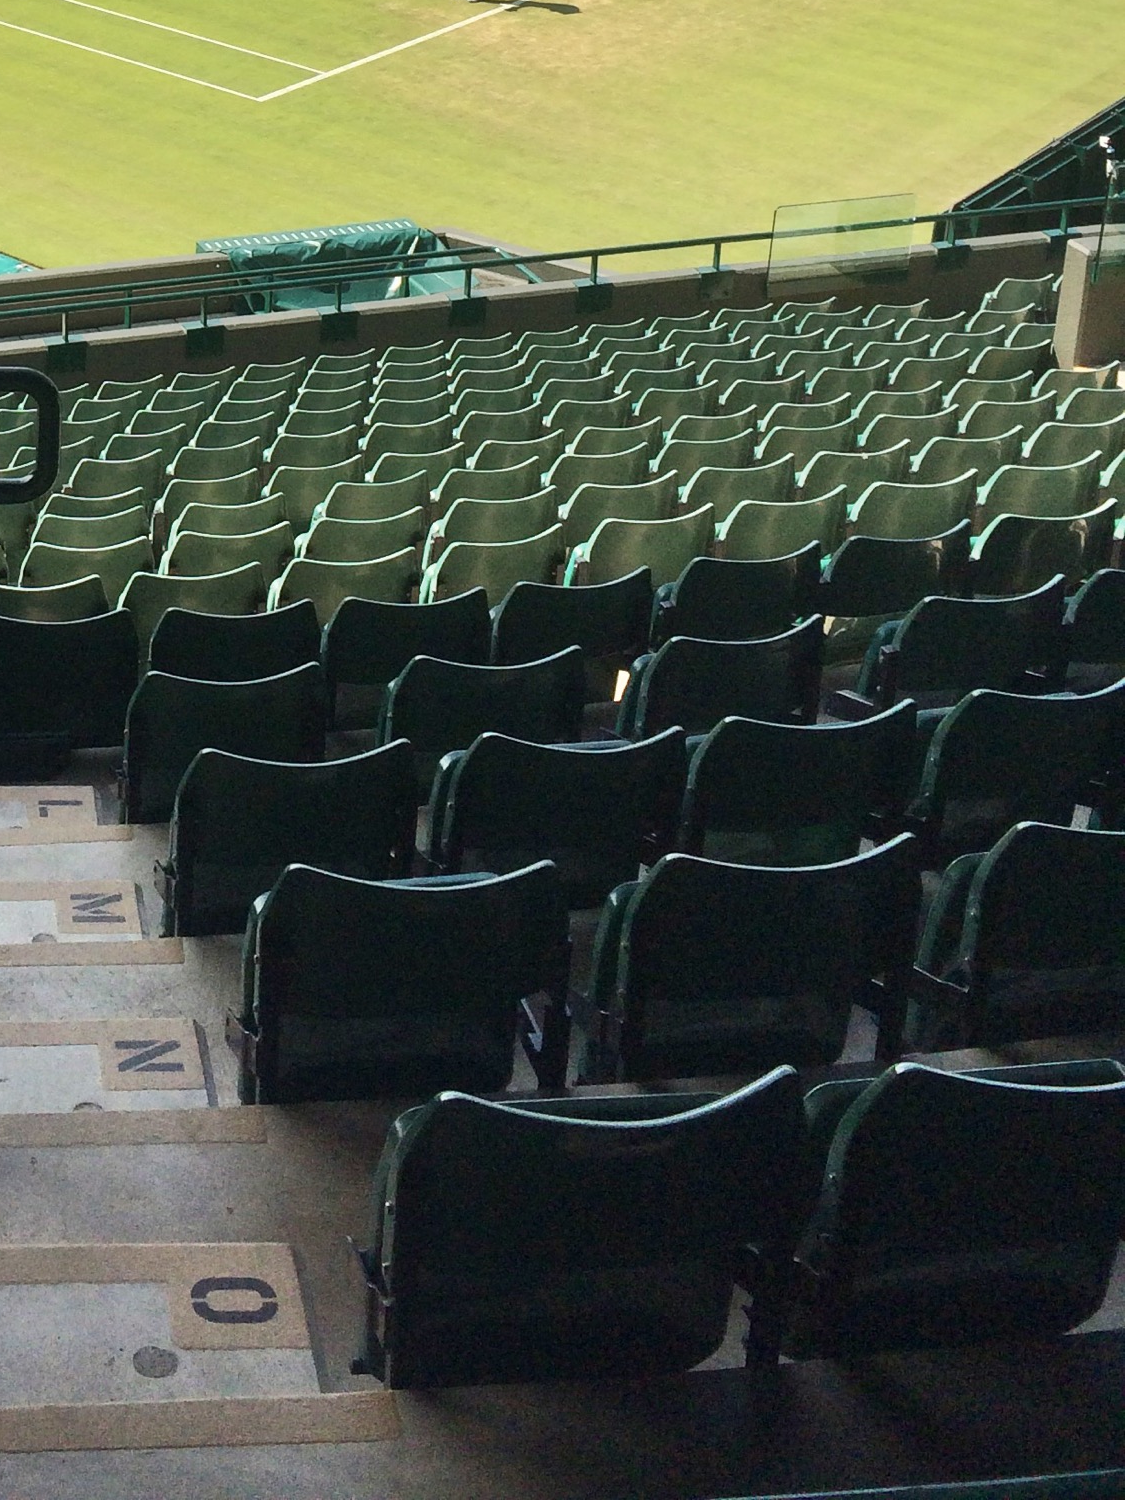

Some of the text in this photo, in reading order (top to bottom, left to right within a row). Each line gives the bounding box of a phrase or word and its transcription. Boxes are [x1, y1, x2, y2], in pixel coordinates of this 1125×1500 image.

[69, 892, 127, 923] M
[114, 1039, 186, 1073] N
[190, 1276, 279, 1324] O
